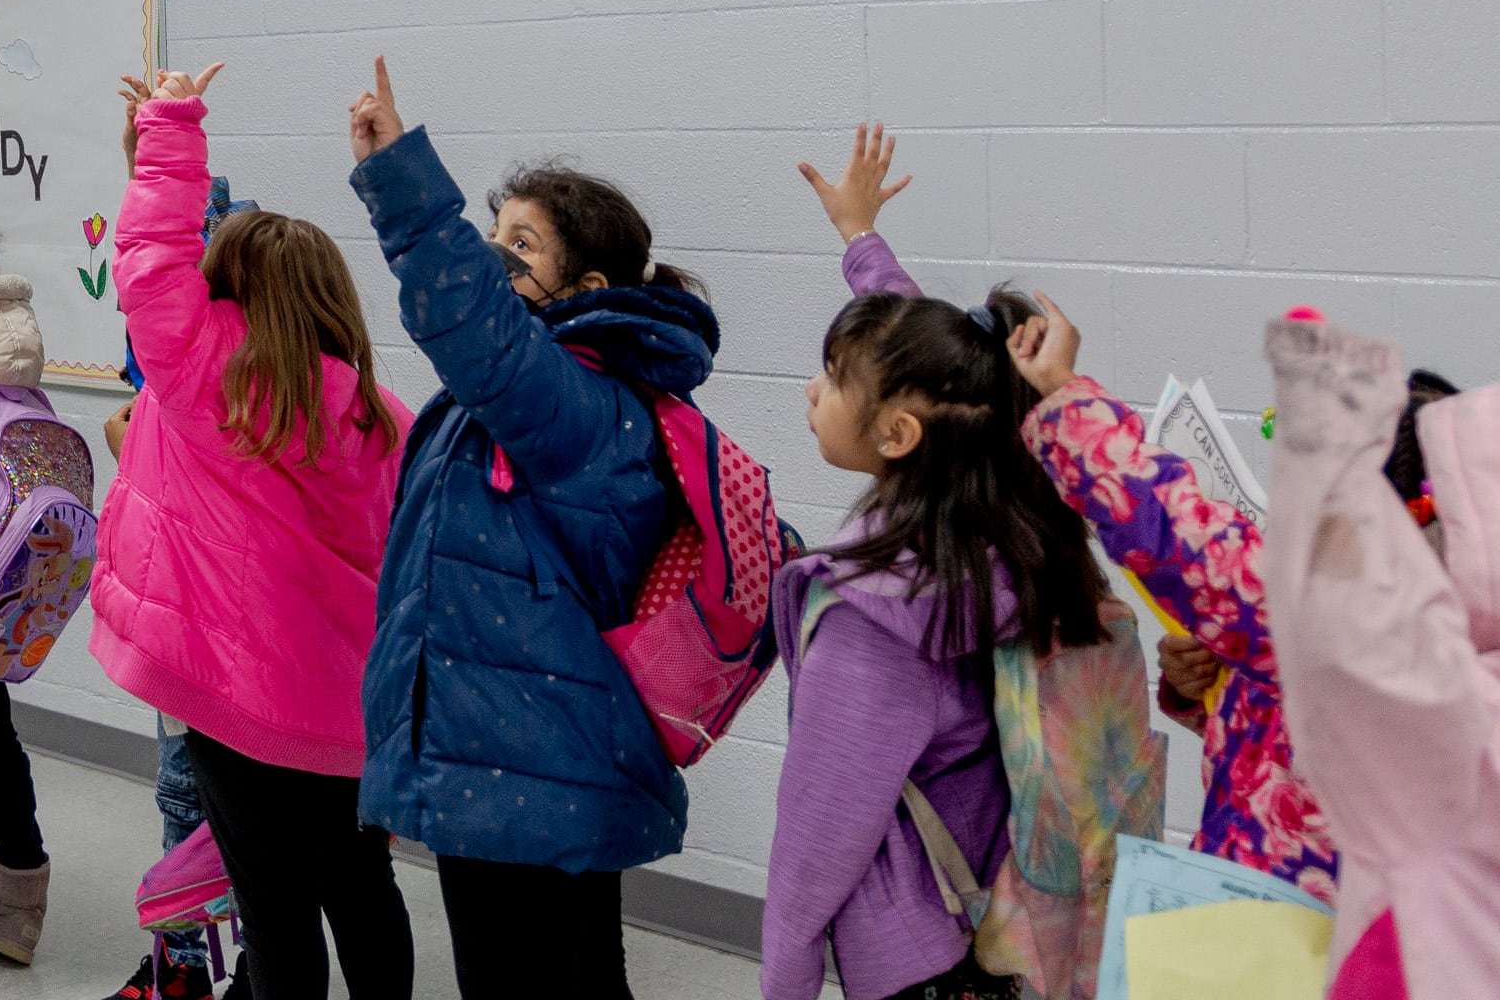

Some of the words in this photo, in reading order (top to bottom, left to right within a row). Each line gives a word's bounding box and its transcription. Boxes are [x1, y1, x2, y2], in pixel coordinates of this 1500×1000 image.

[1184, 415, 1195, 428] I
[1193, 427, 1214, 459] CAN
[1213, 457, 1236, 495] SORT
